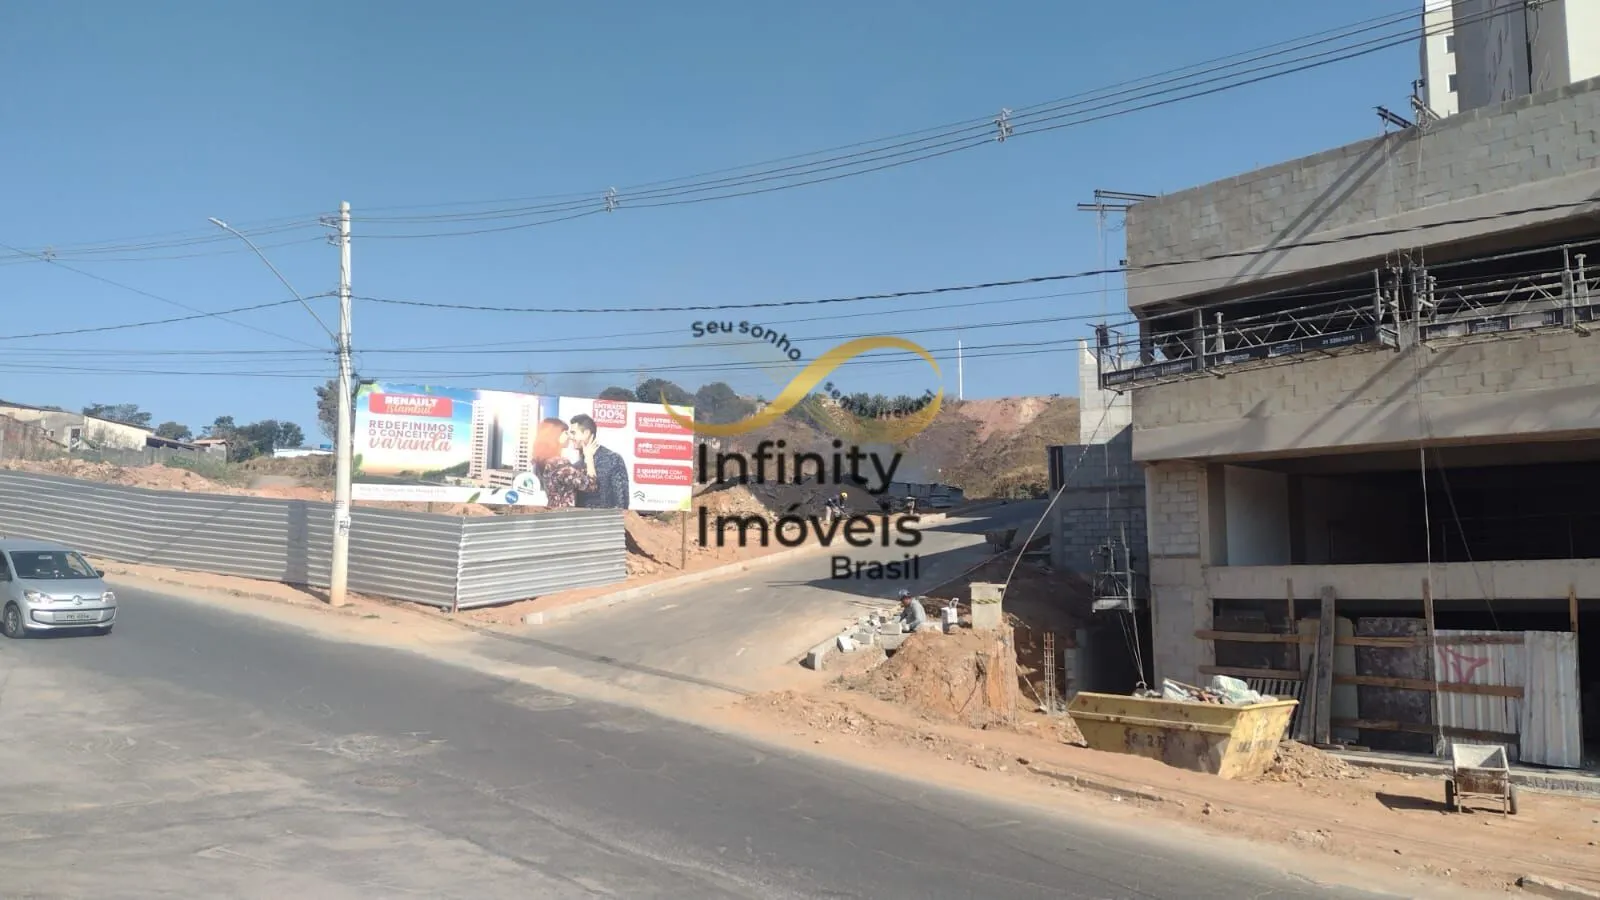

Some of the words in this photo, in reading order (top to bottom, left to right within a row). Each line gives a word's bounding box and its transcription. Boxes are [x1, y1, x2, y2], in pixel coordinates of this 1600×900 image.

[384, 395, 439, 407] RENAULT
[594, 408, 625, 420] 100%
[369, 419, 455, 433] REDEFINIMOS
[369, 428, 377, 437] O
[380, 429, 435, 440] CONCEITO
[440, 432, 453, 440] DE
[369, 432, 452, 452] varanda
